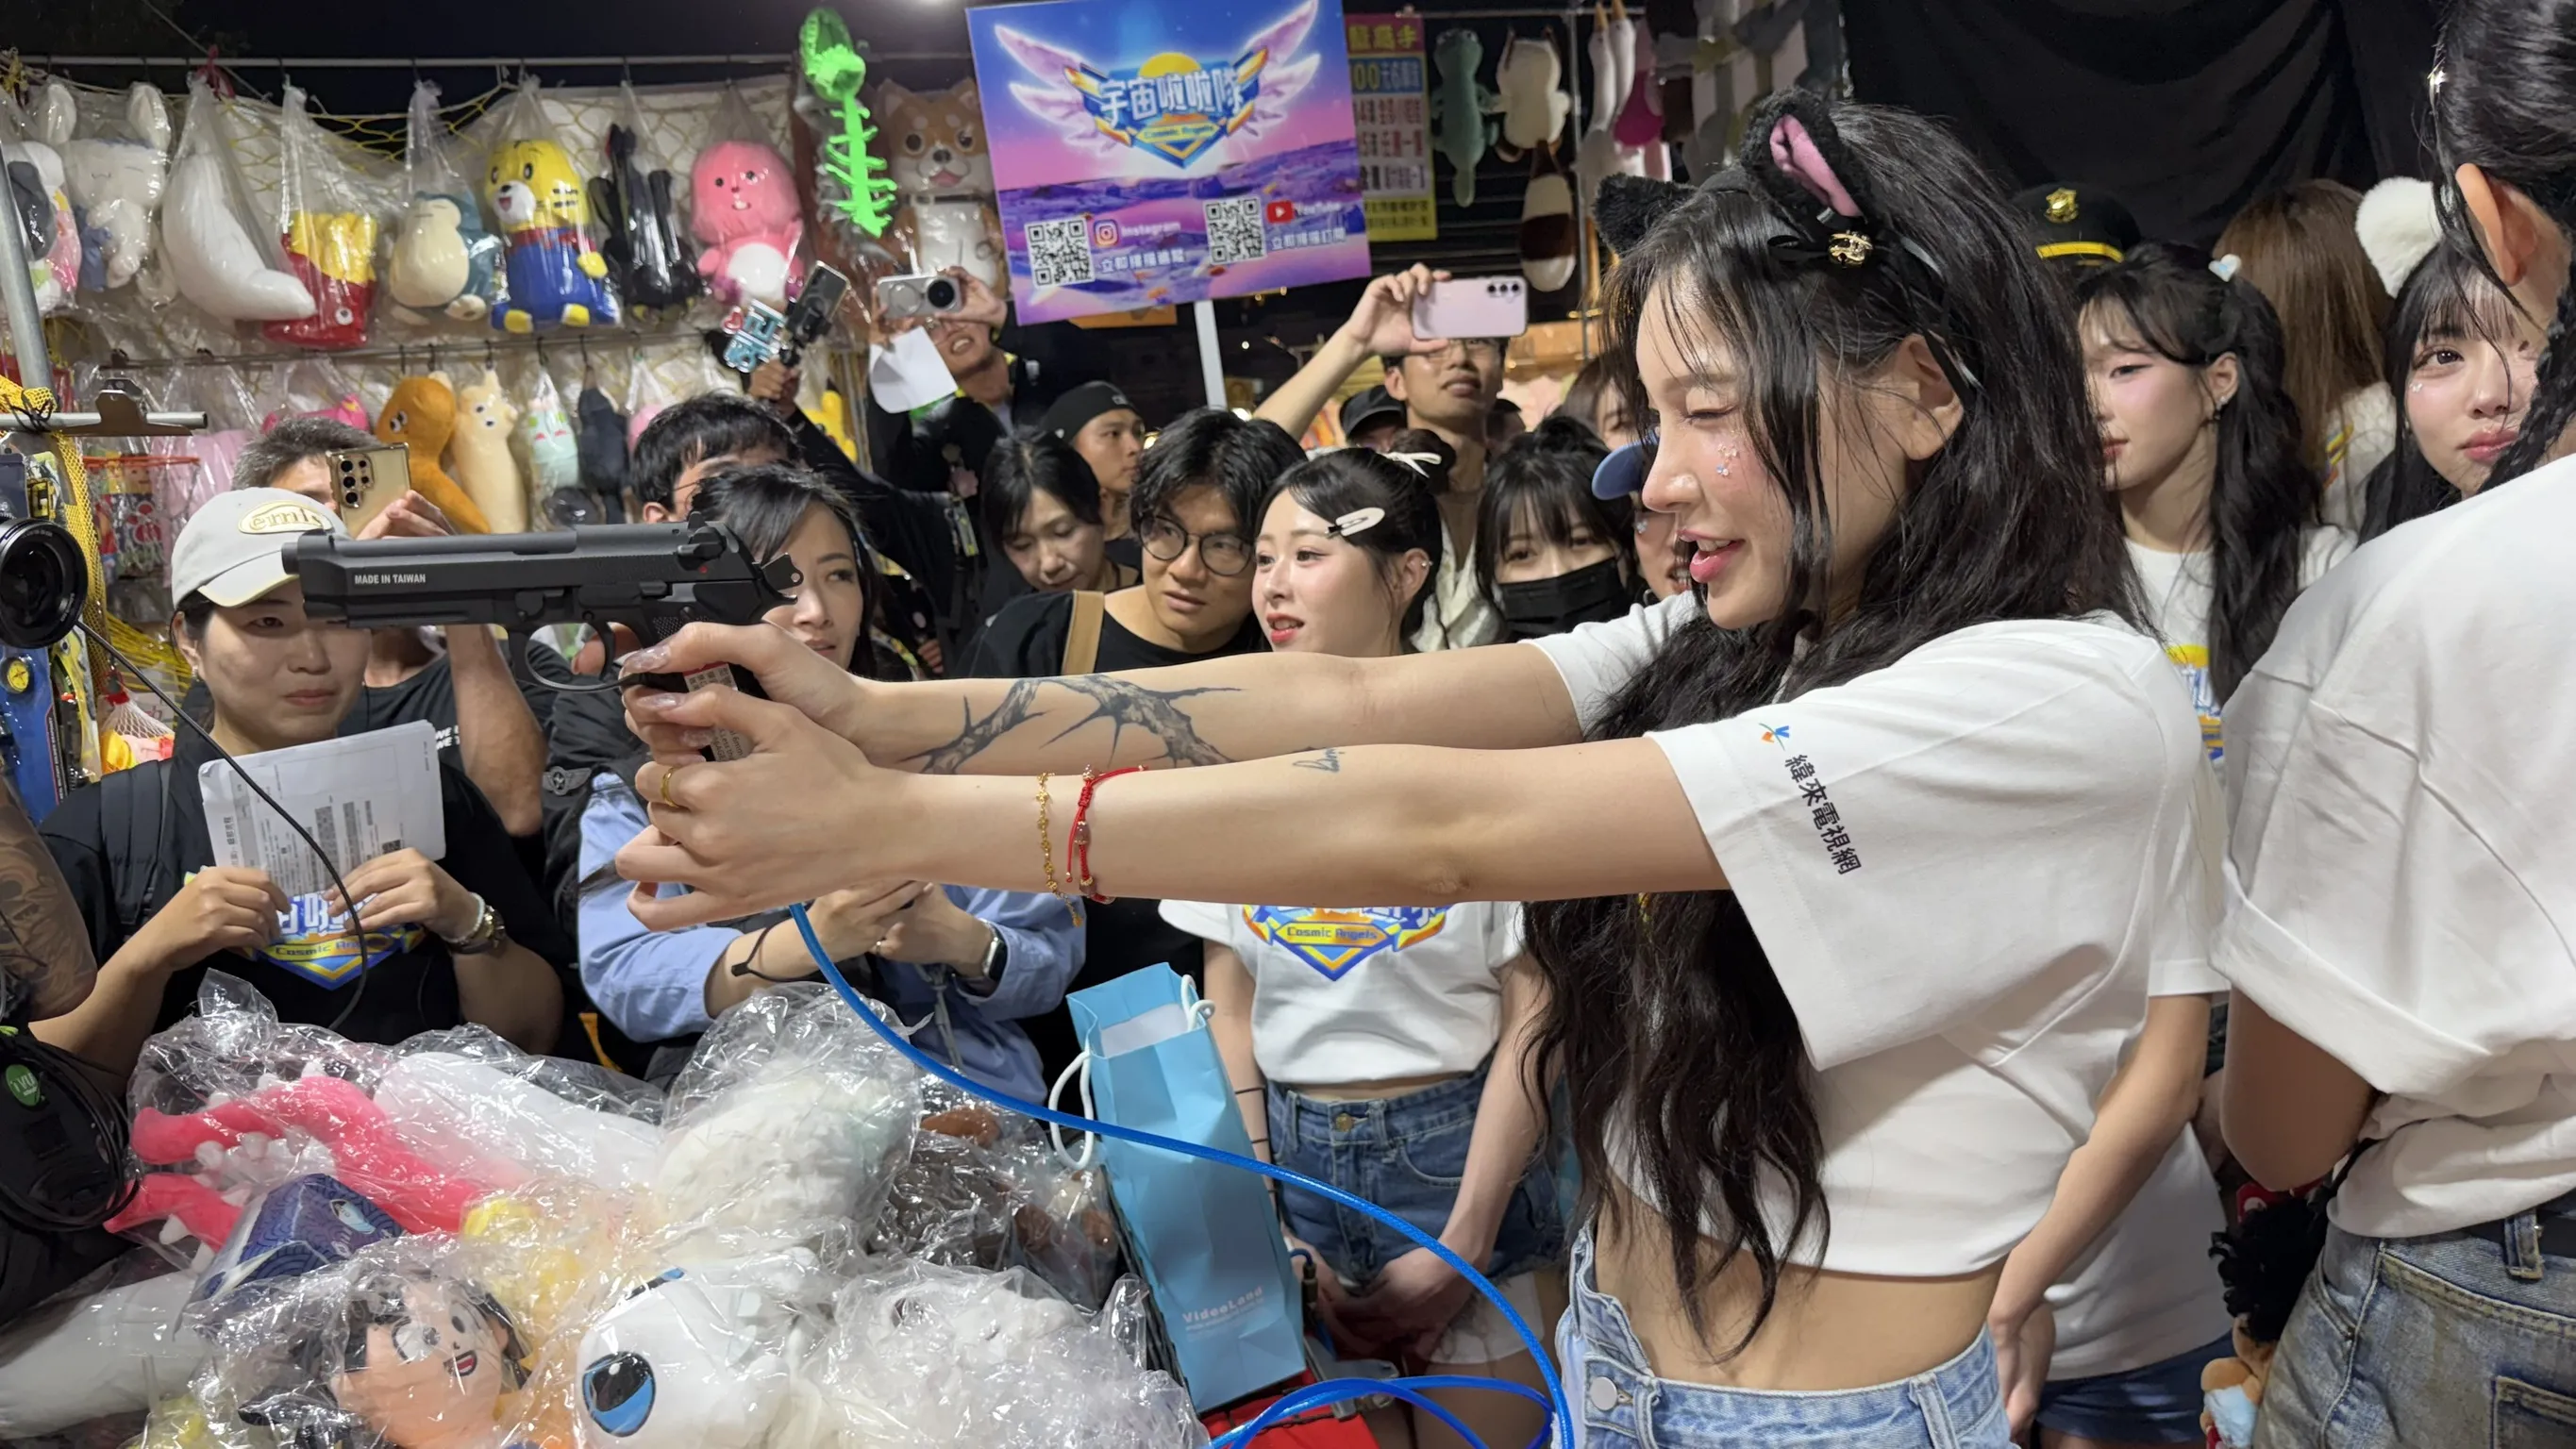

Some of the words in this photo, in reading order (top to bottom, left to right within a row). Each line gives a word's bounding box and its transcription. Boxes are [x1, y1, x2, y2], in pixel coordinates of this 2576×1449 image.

[1099, 67, 1244, 129] 宇宙啦啦隊
[1121, 222, 1181, 238] Instagram
[354, 574, 379, 585] MADE
[381, 574, 392, 584] IN
[393, 573, 427, 584] TAIWAN
[1784, 755, 1862, 875] 緯來電視網
[1286, 925, 1332, 938] Cosmic
[1335, 927, 1377, 941] Angels
[275, 943, 331, 956] Cosmic
[1181, 1286, 1263, 1323] VideoLand
